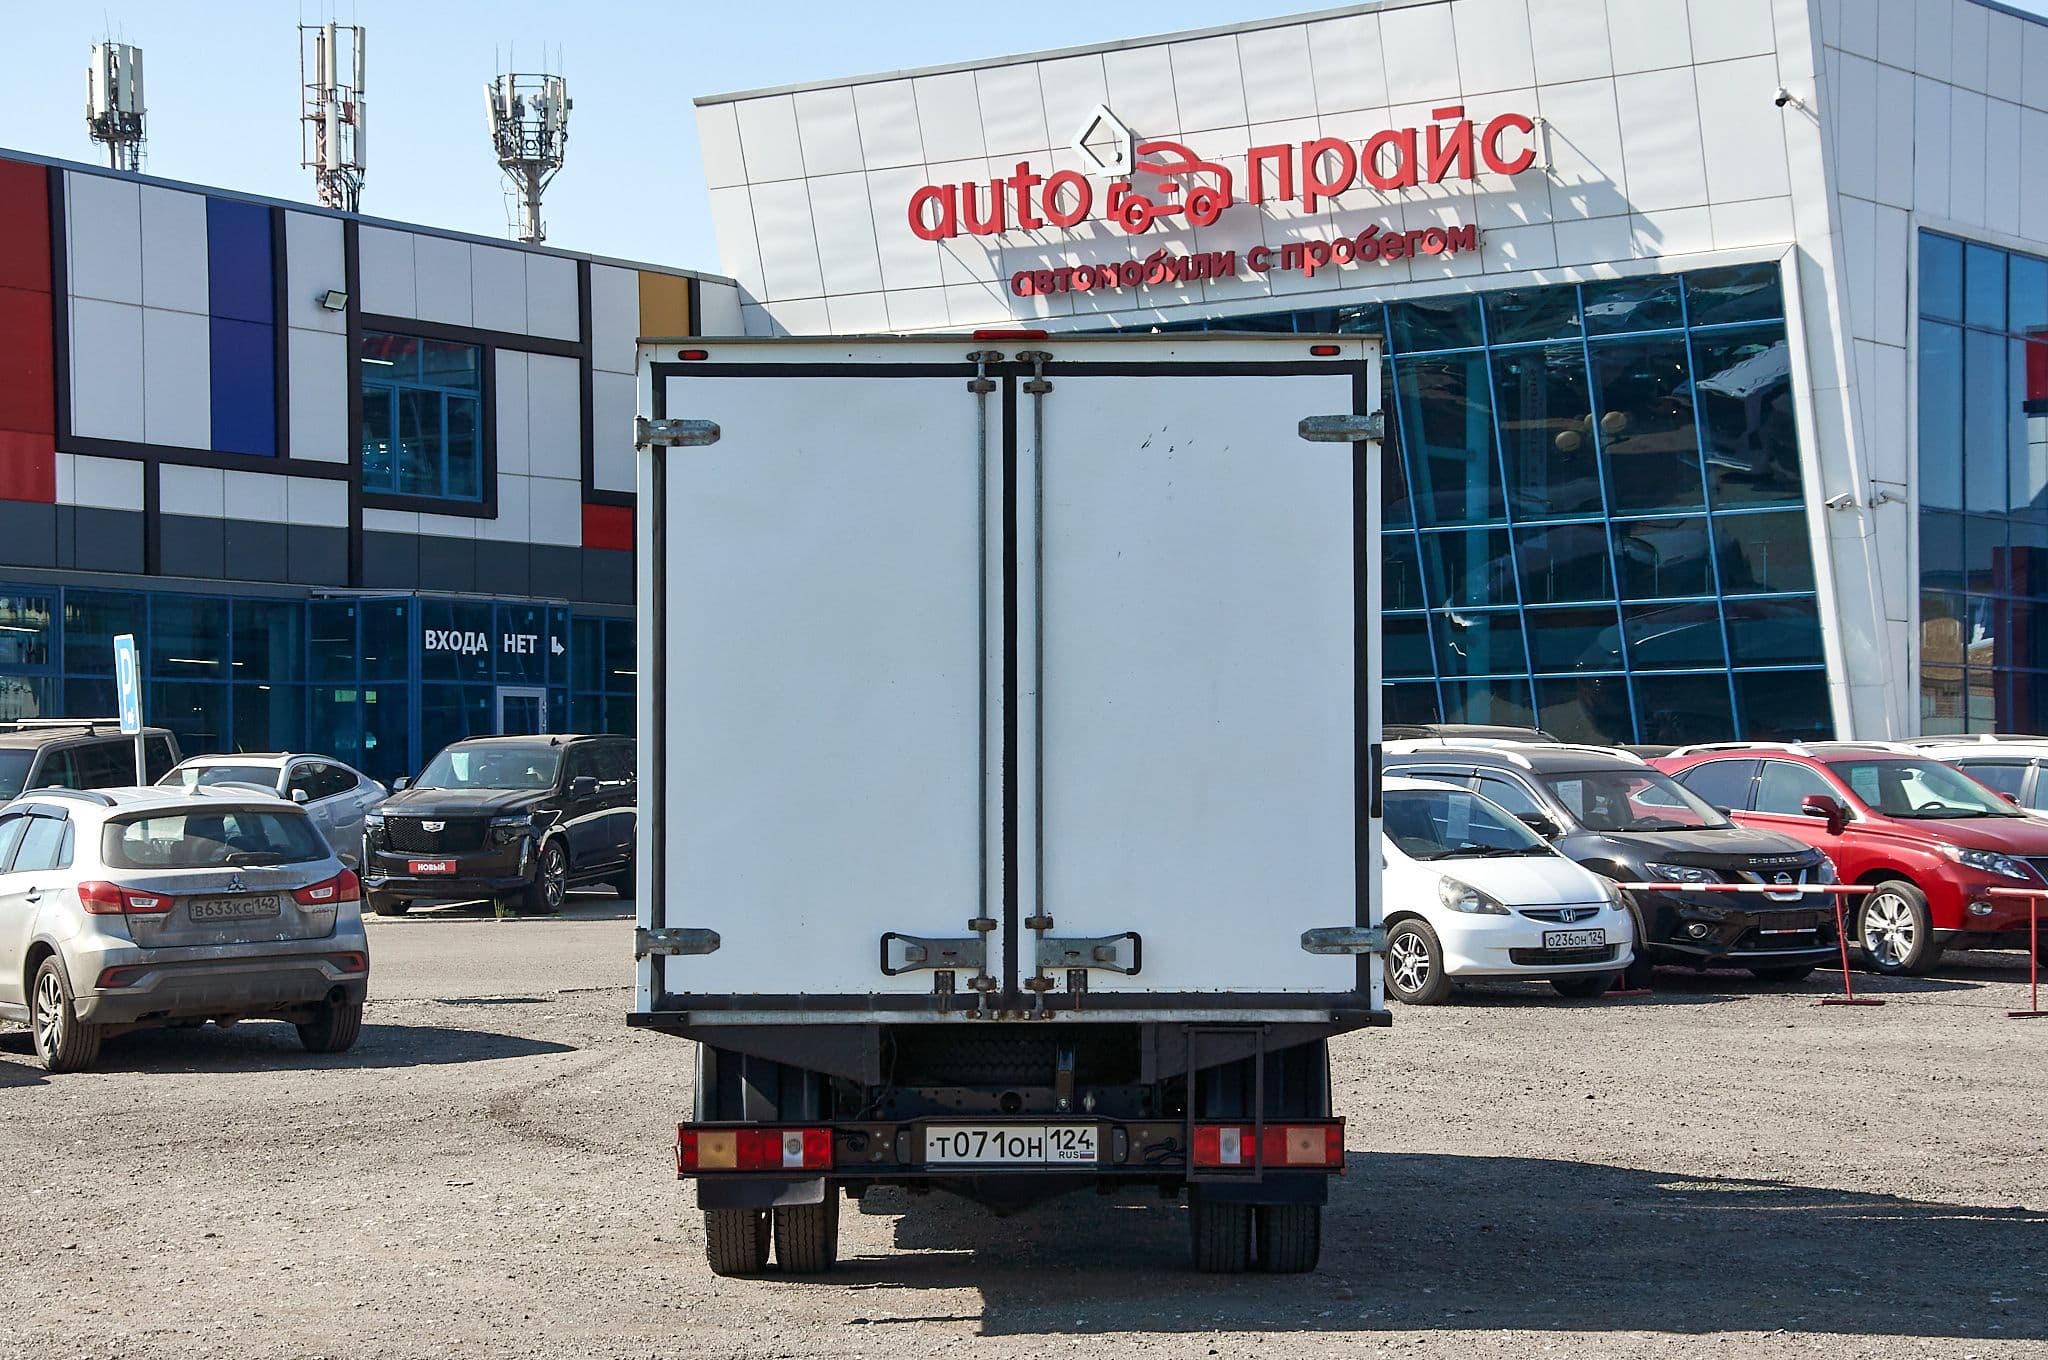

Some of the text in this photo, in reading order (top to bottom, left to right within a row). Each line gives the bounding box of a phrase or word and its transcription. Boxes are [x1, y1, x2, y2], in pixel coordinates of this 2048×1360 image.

[908, 106, 1536, 240] auto прайс
[1010, 224, 1476, 297] автомобили с пробегом
[425, 629, 538, 656] ВХОДА НЕТ
[119, 648, 133, 722] P
[1050, 1129, 1091, 1150] 124
[1058, 1151, 1079, 1159] RUS
